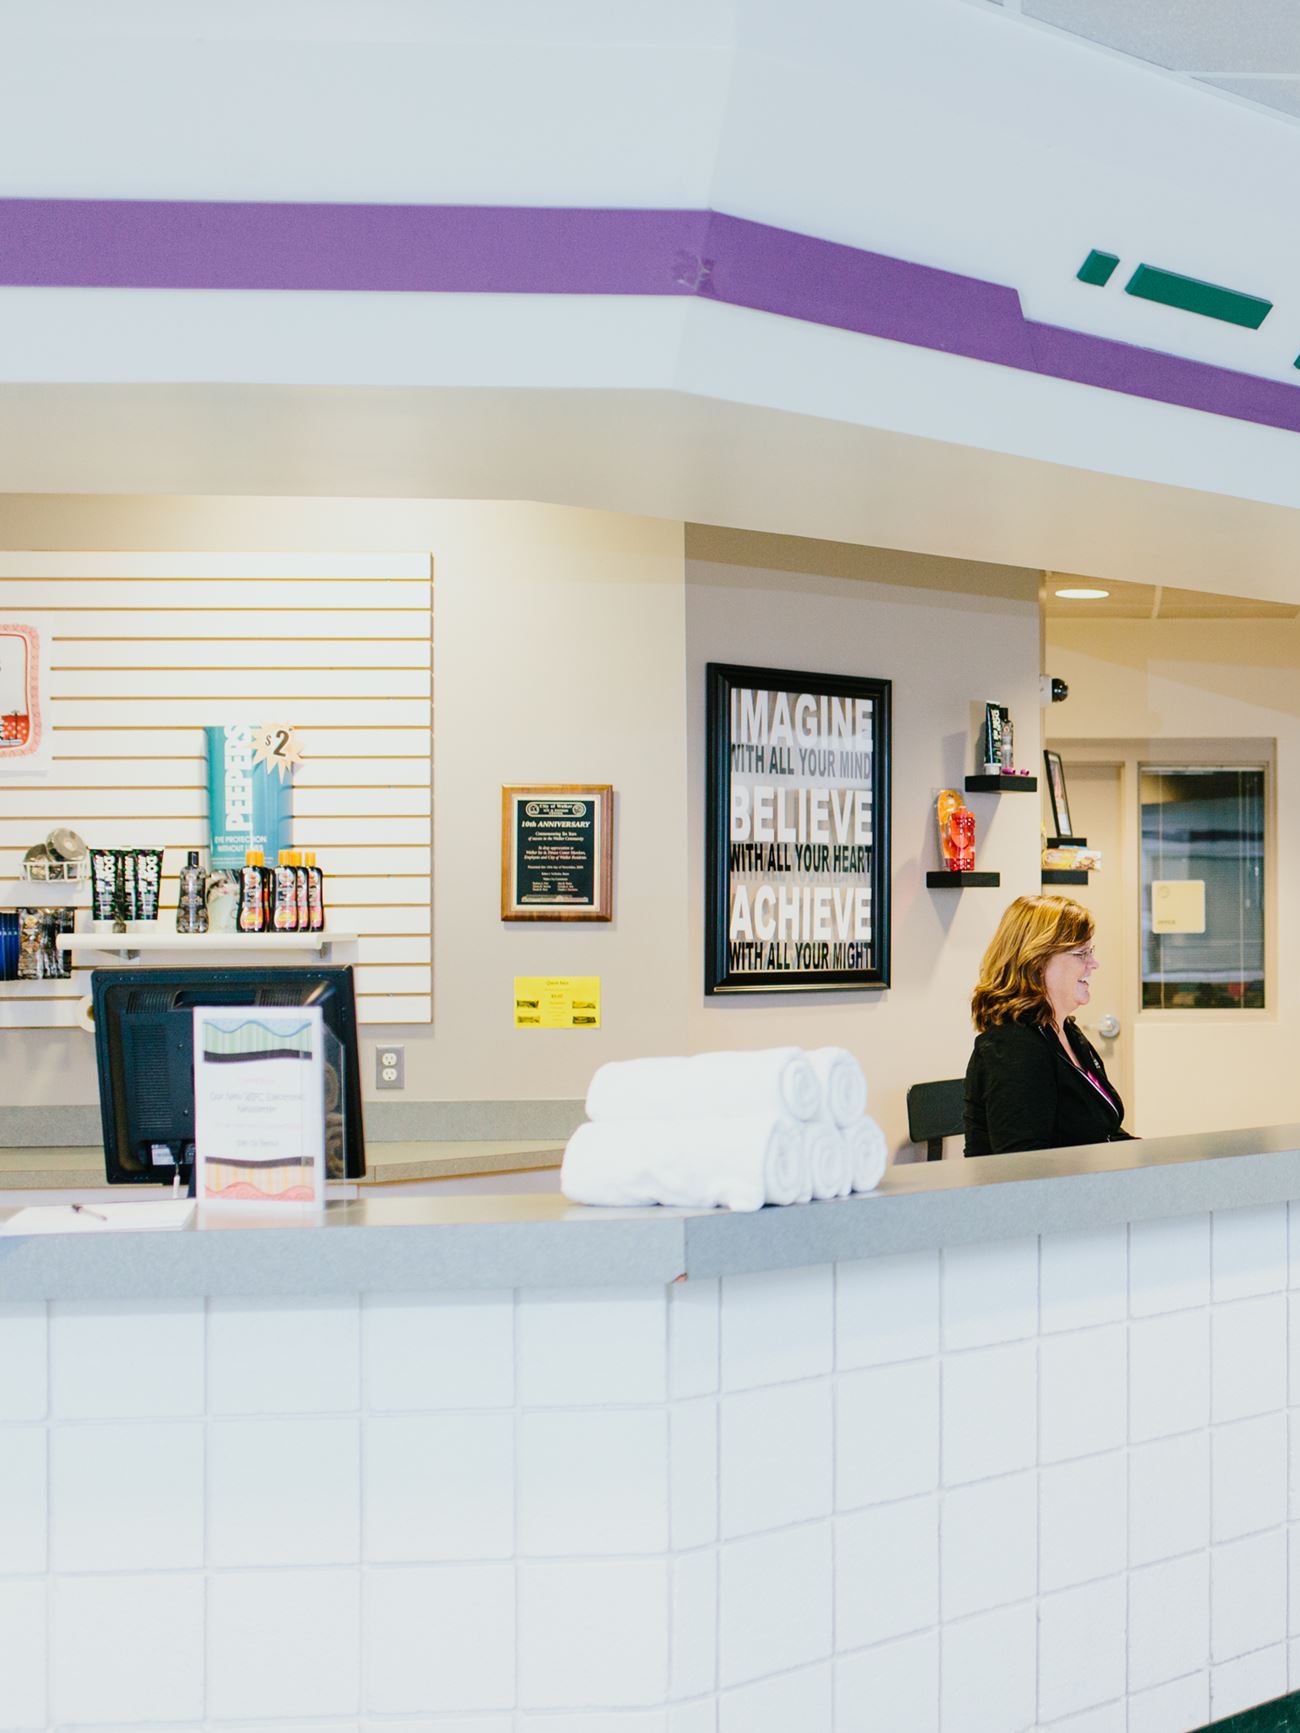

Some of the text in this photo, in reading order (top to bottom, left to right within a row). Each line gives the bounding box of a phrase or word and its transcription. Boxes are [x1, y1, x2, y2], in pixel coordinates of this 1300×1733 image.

[731, 688, 873, 752] IMAGINE
[769, 746, 795, 775] ALL
[799, 747, 836, 778] YOUR
[840, 751, 872, 780] MIND
[731, 785, 873, 845] BELIEVE
[767, 843, 791, 872] ALL
[795, 843, 830, 872] YOUR
[833, 844, 872, 873] HEART
[729, 885, 872, 940] ACHIEVE
[730, 942, 872, 971] WITH ALL YOUR MIGHT
